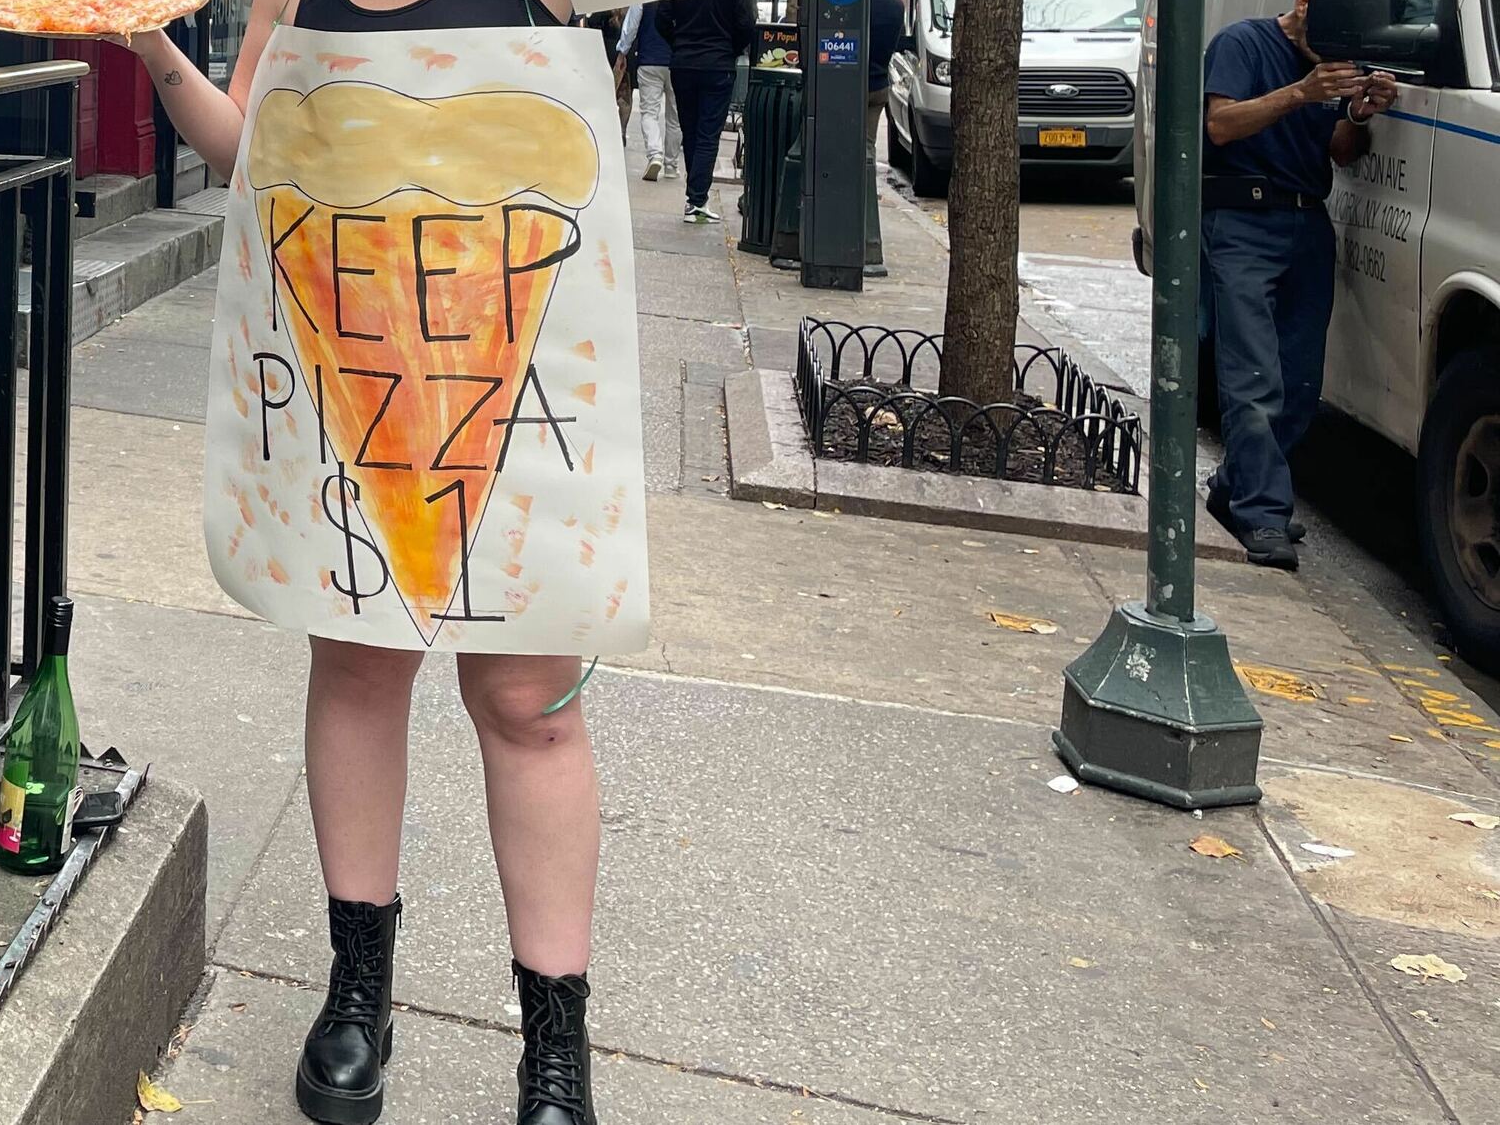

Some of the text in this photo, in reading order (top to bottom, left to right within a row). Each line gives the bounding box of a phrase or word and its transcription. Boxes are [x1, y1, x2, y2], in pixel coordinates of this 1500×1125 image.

[764, 31, 798, 43] By Popul
[824, 42, 854, 51] 106441
[1385, 157, 1408, 193] AVE.
[1363, 198, 1381, 229] NY
[1381, 205, 1412, 243] 10022
[269, 196, 581, 343] KEEP
[253, 352, 578, 473] PIZZA
